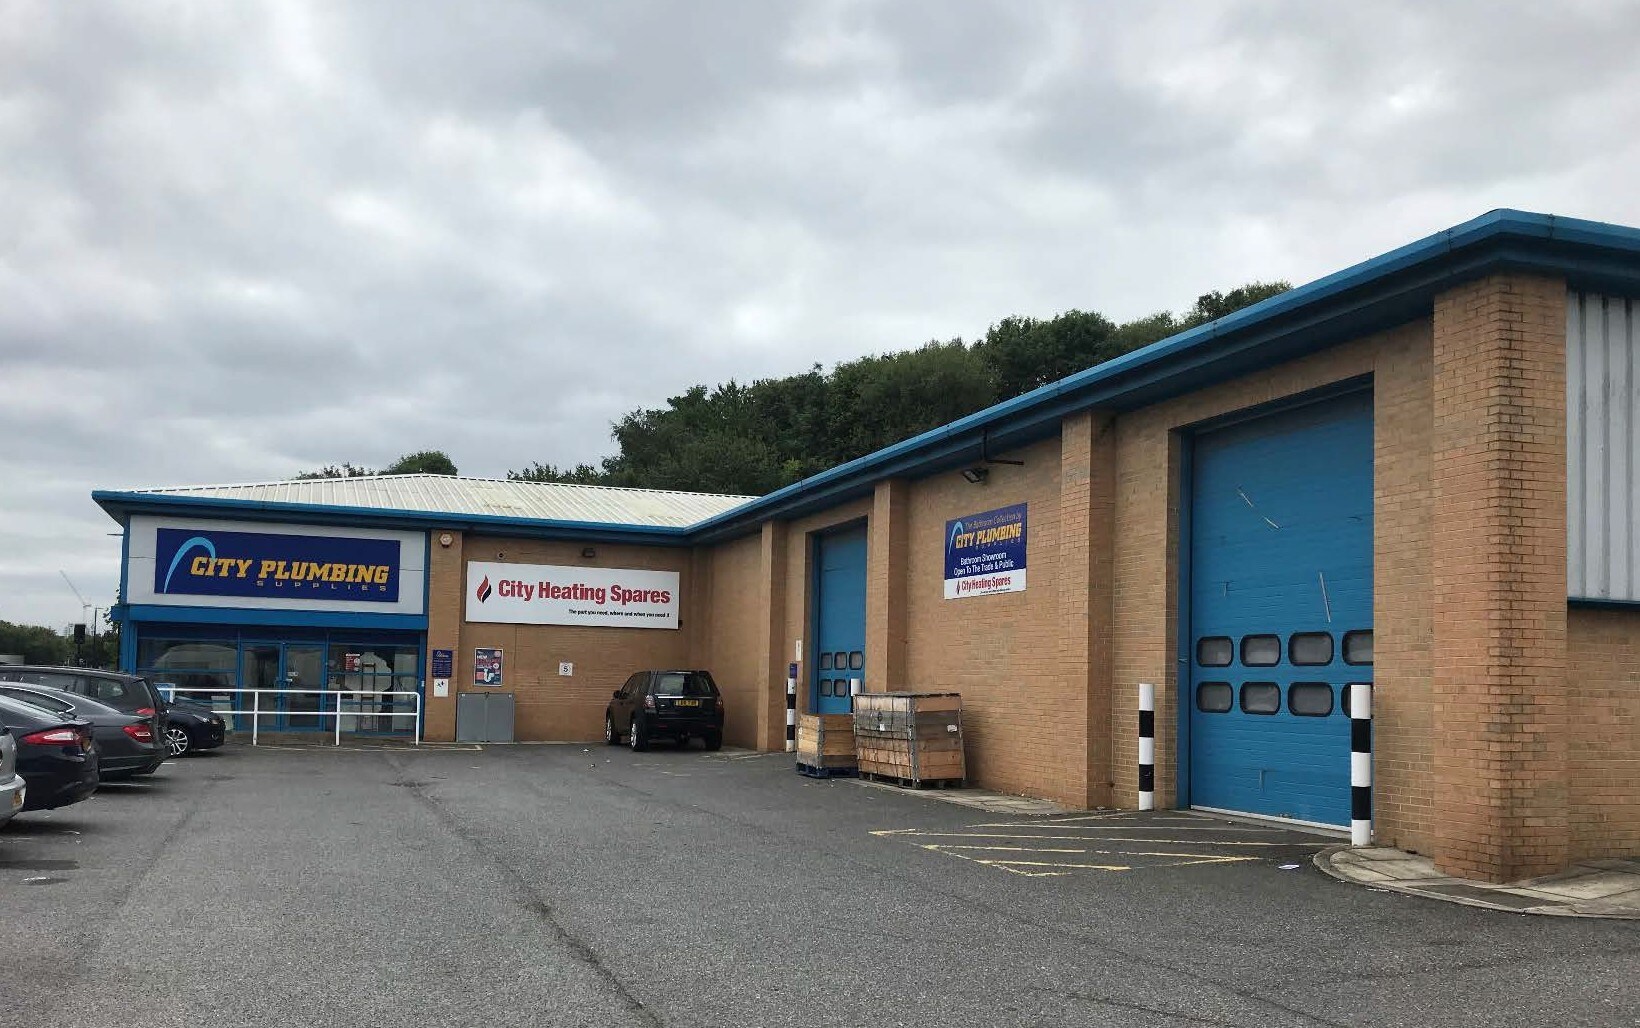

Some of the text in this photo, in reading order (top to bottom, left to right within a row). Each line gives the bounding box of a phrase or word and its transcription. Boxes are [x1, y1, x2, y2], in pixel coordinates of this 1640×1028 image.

[955, 522, 1022, 549] CITY PLUMBING
[953, 559, 1014, 577] Open To The Trade & Public
[960, 552, 1007, 566] Bathroom Showroom
[190, 556, 390, 584] CITY PLUMBING
[256, 580, 388, 592] SUPPLIES
[498, 579, 671, 605] City Heating Spares
[961, 580, 972, 592] City
[972, 578, 992, 590] Heating
[991, 576, 1011, 589] Spares
